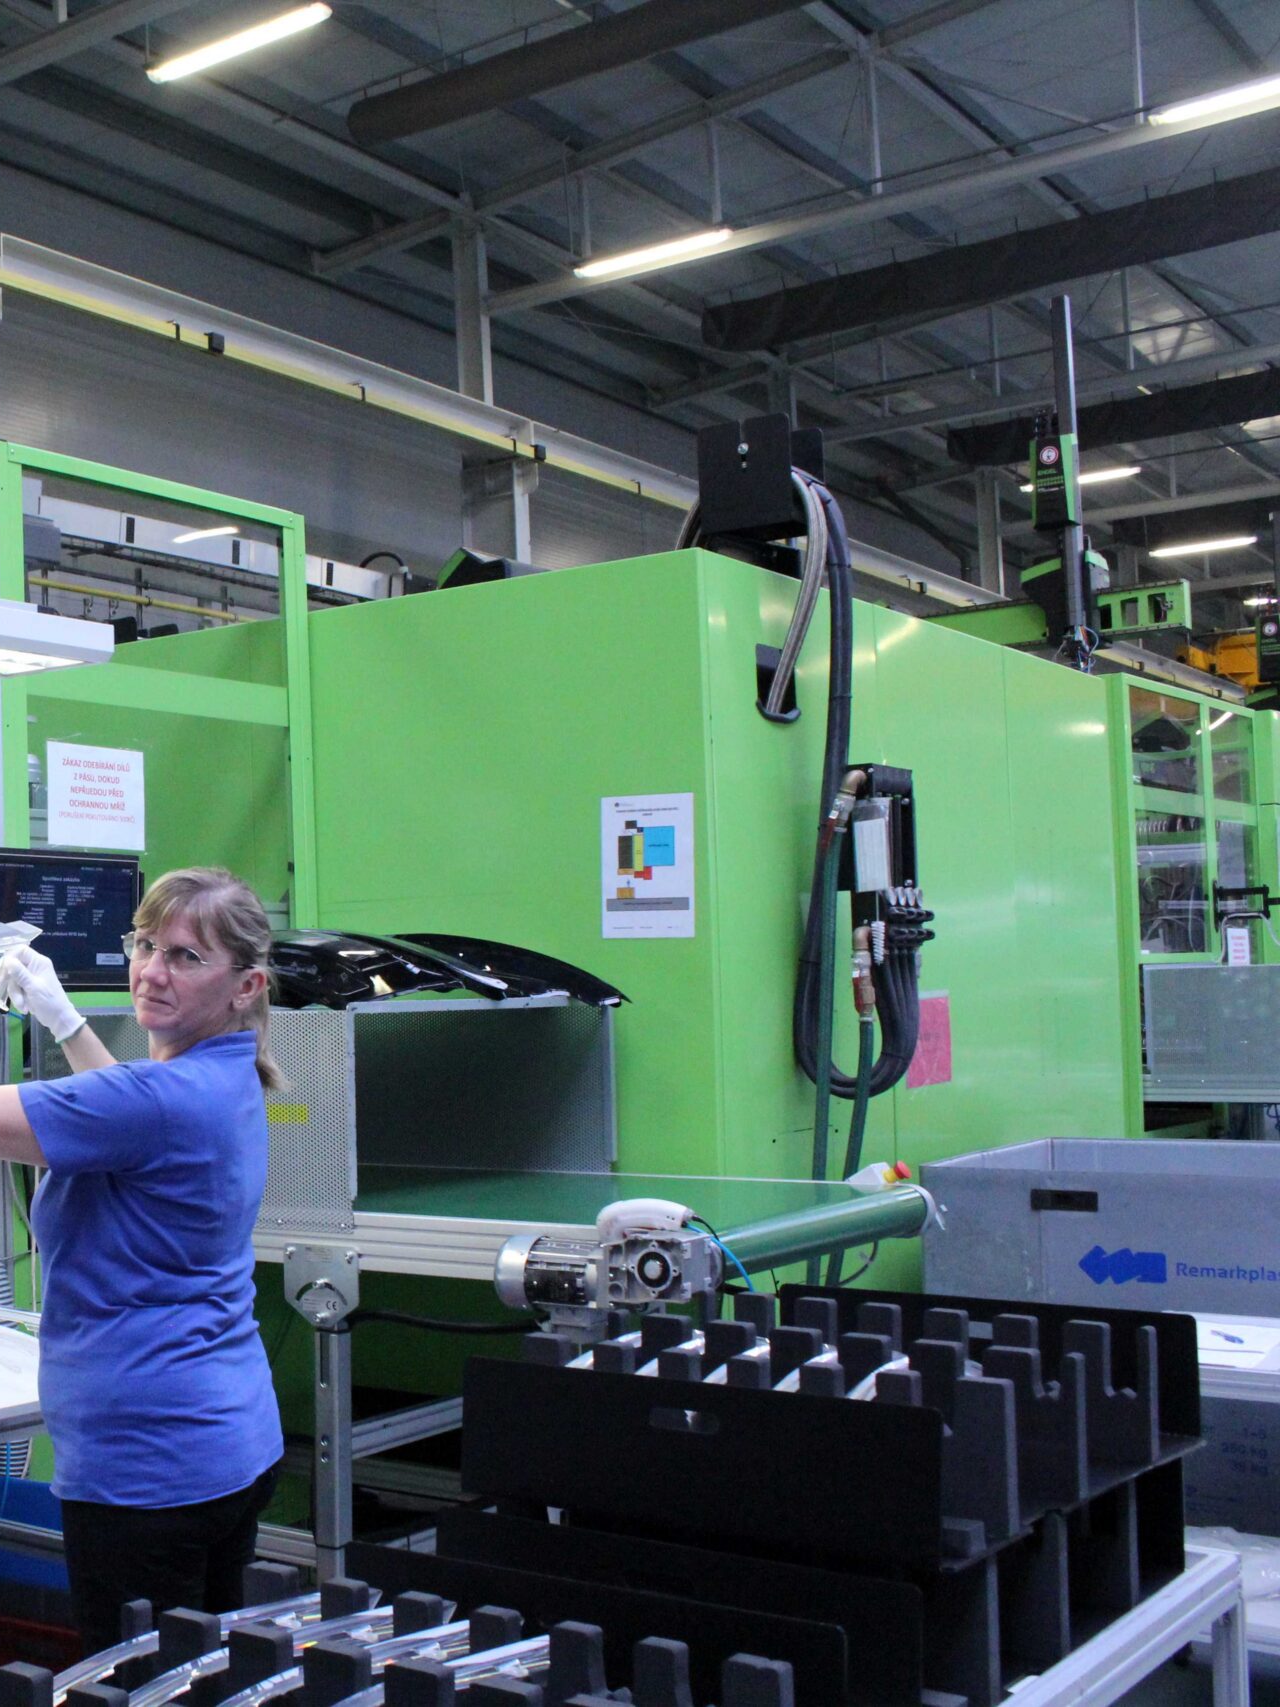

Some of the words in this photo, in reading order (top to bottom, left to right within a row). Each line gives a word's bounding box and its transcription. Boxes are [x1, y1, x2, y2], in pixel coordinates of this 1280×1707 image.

[62, 757, 82, 767] ZÁKAZ
[98, 775, 120, 784] DOKUD
[69, 800, 108, 810] OCHRANNOU
[1176, 1262, 1280, 1284] Remarkpla
